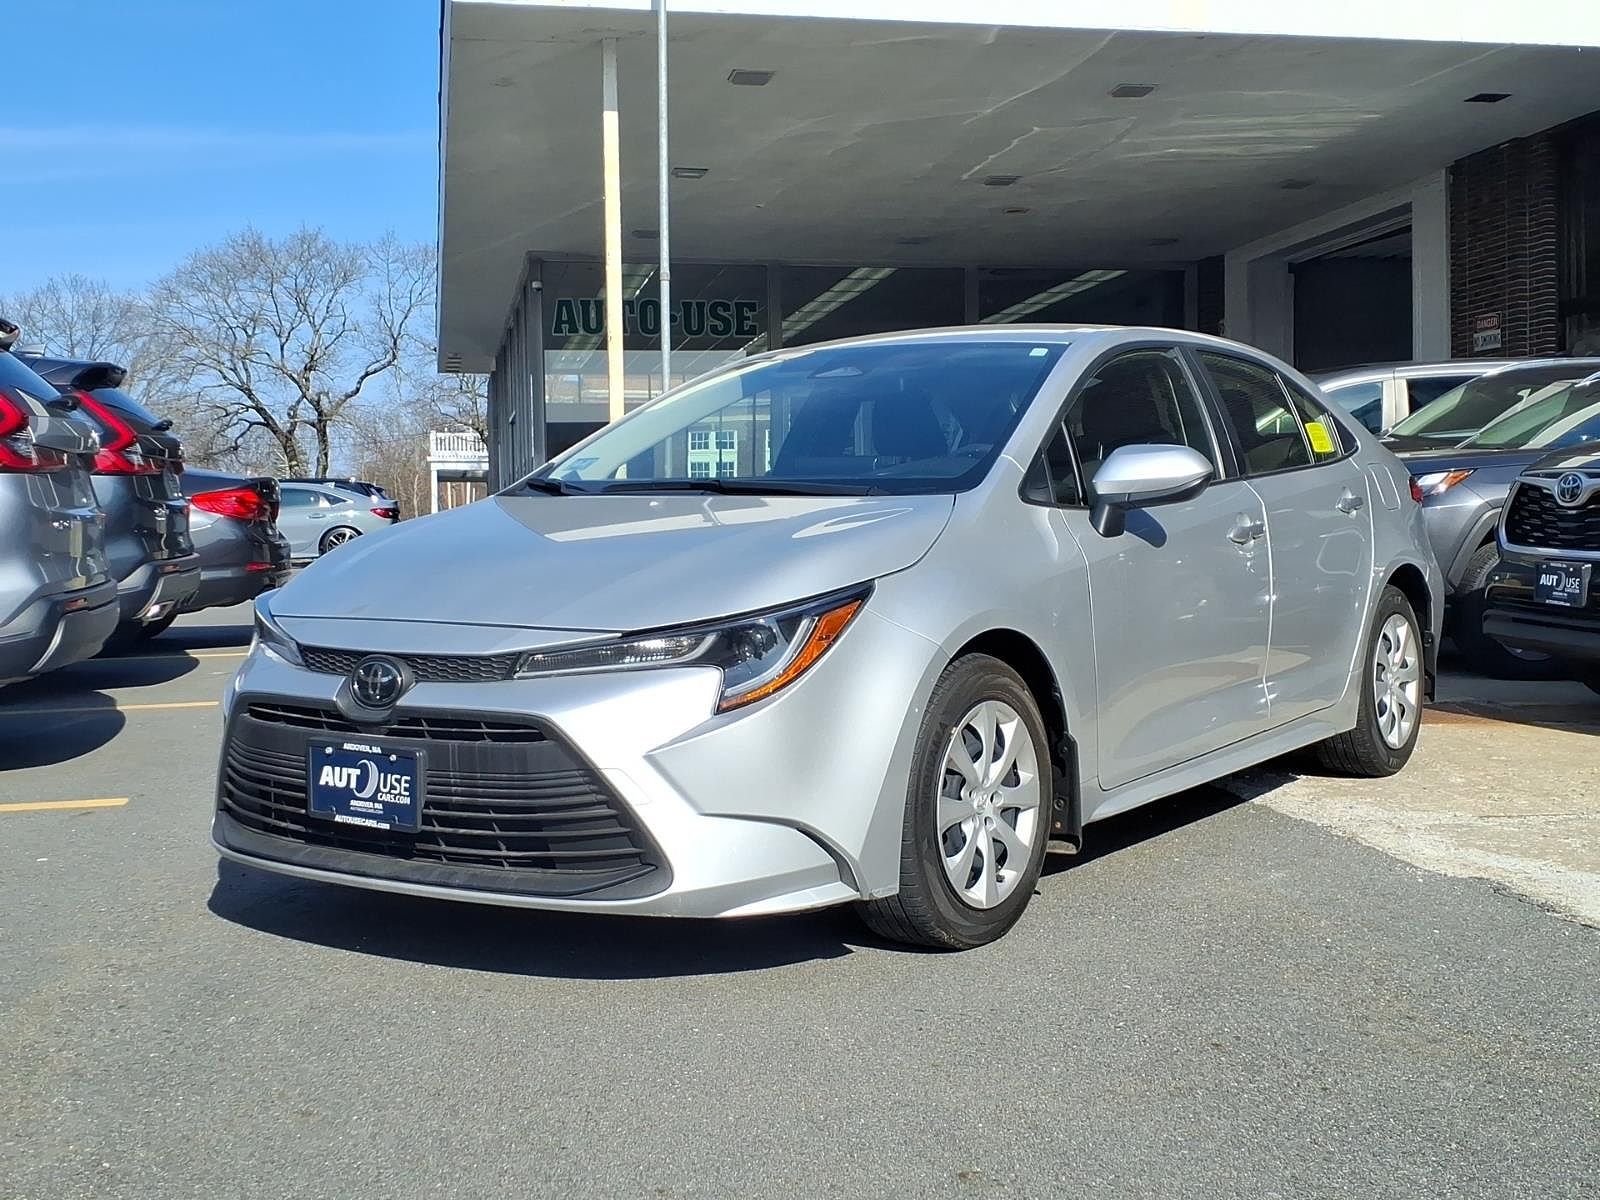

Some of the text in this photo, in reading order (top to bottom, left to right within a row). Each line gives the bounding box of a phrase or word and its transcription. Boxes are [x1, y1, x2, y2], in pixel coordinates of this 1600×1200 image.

[1566, 577, 1580, 589] USE
[380, 773, 411, 795] USE
[377, 792, 411, 805] CARS.COM
